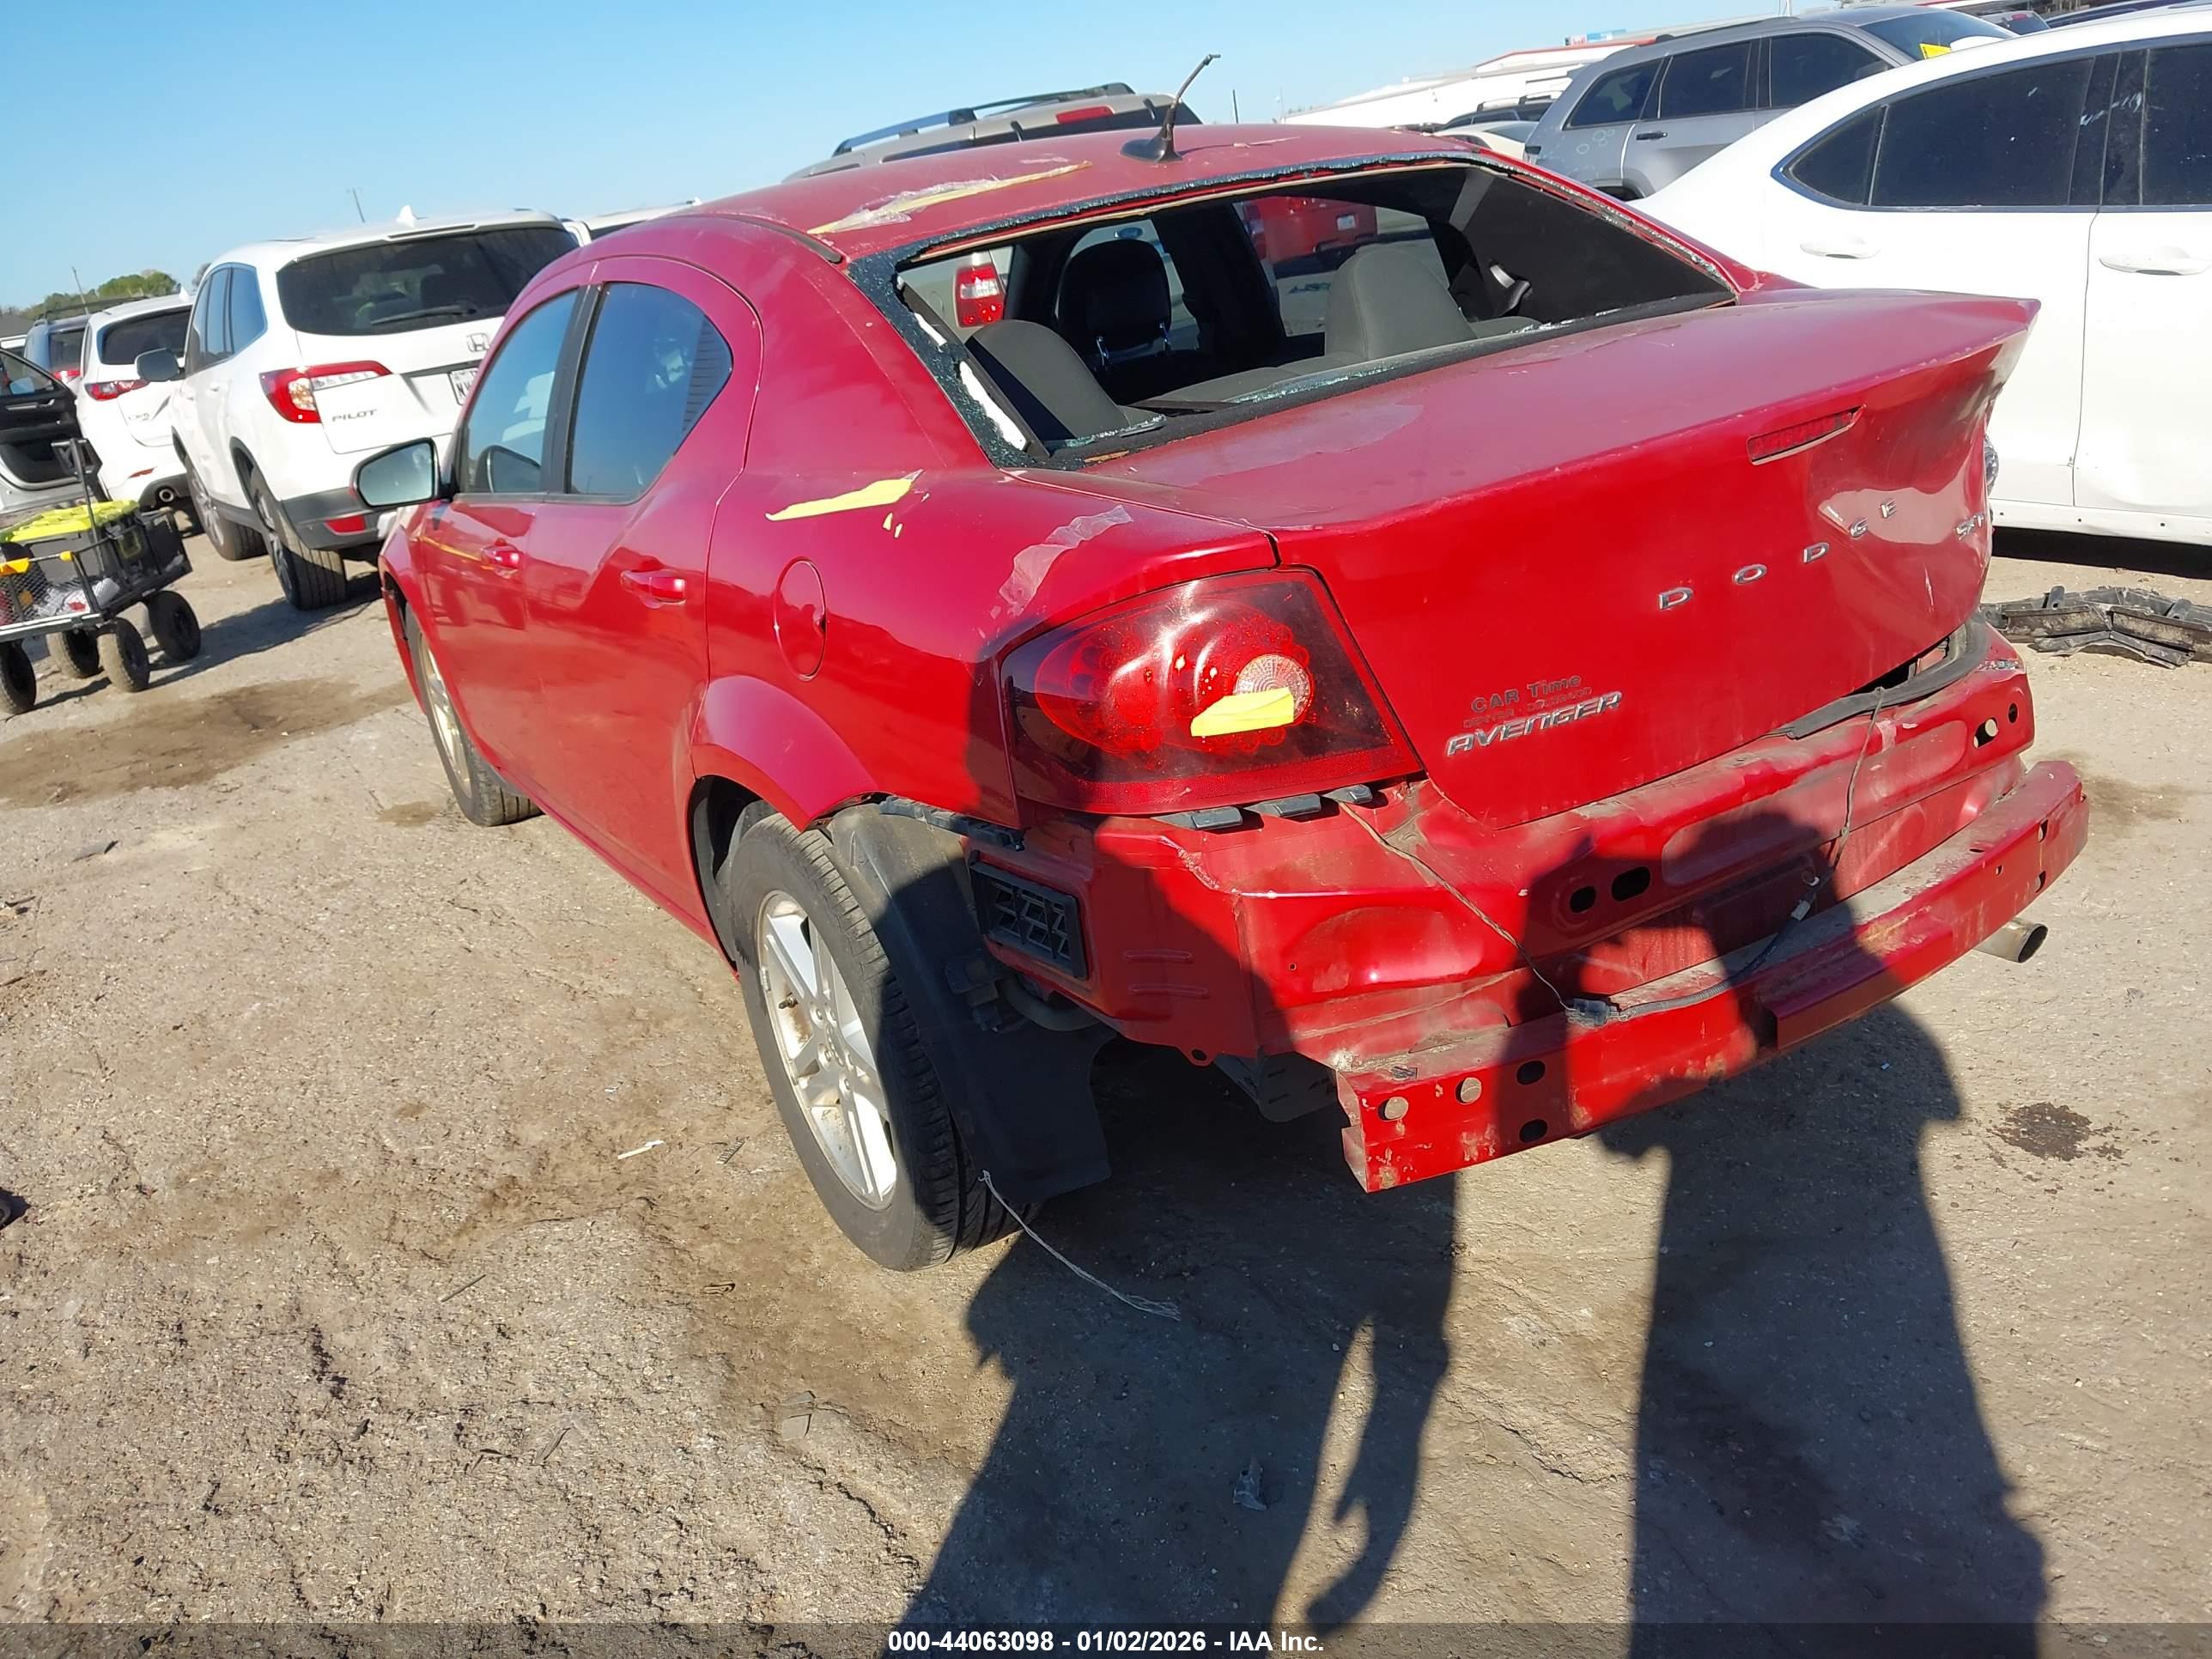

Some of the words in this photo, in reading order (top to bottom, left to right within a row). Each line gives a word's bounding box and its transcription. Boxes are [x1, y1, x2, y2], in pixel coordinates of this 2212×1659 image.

[331, 409, 378, 422] PILOT
[1658, 497, 1899, 611] DODGE
[1471, 689, 1520, 714] CAR
[1527, 675, 1582, 698] Time
[1446, 690, 1622, 757] AVENGER
